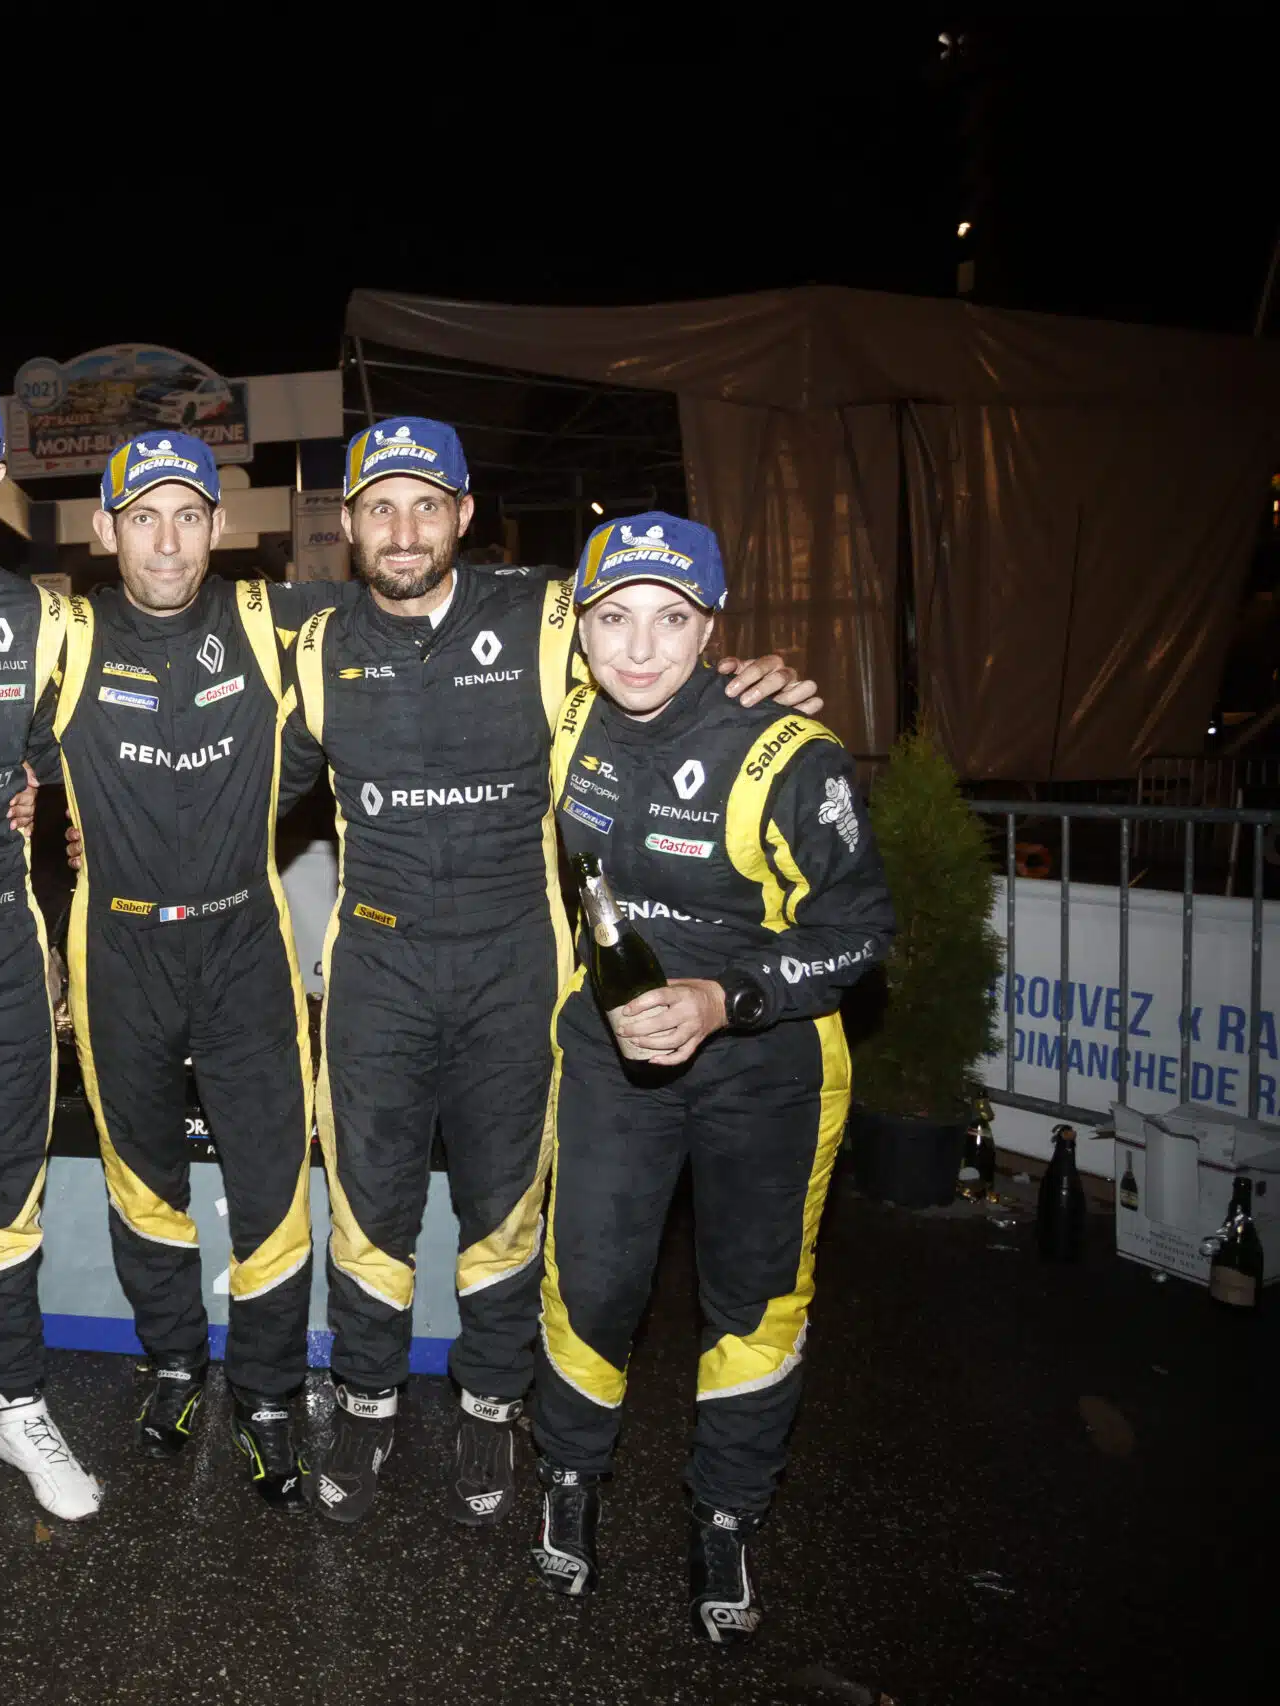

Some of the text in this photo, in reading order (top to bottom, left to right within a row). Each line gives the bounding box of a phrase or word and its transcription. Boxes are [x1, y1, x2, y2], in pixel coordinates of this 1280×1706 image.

[128, 457, 198, 480] MICHELIN
[363, 447, 436, 472] MICHELIN
[602, 550, 693, 572] MICHELIN
[454, 669, 523, 687] RENAULT
[206, 681, 239, 701] Castrol
[120, 736, 234, 771] RENAULT
[746, 721, 806, 781] Sabelt
[392, 783, 514, 807] RENAULT
[649, 803, 719, 824] RENAULT
[659, 838, 704, 856] Castrol
[116, 890, 249, 917] Sabelt R. FOSTIER
[359, 906, 391, 925] Sabelt
[1013, 1027, 1280, 1117] DIMANCHE DE R
[353, 1403, 379, 1414] OMP
[473, 1403, 500, 1417] OMP
